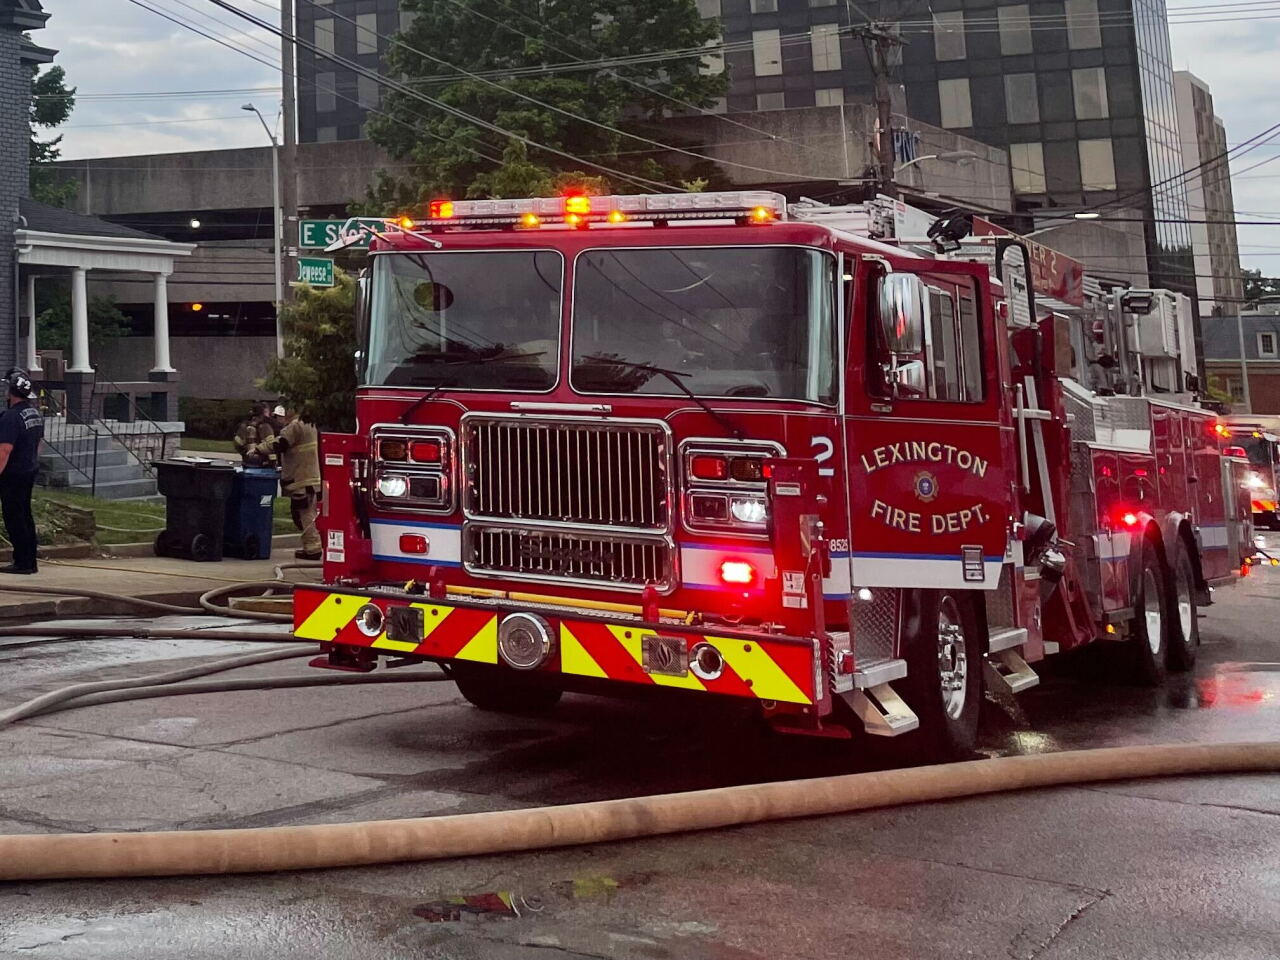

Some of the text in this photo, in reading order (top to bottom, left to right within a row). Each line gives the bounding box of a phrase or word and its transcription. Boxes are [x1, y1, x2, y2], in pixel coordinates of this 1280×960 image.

[303, 223, 316, 245] E
[1050, 251, 1058, 276] 2
[810, 435, 835, 477] 2
[861, 441, 988, 478] LEXINGTON
[871, 499, 990, 534] FIRE DEPT.
